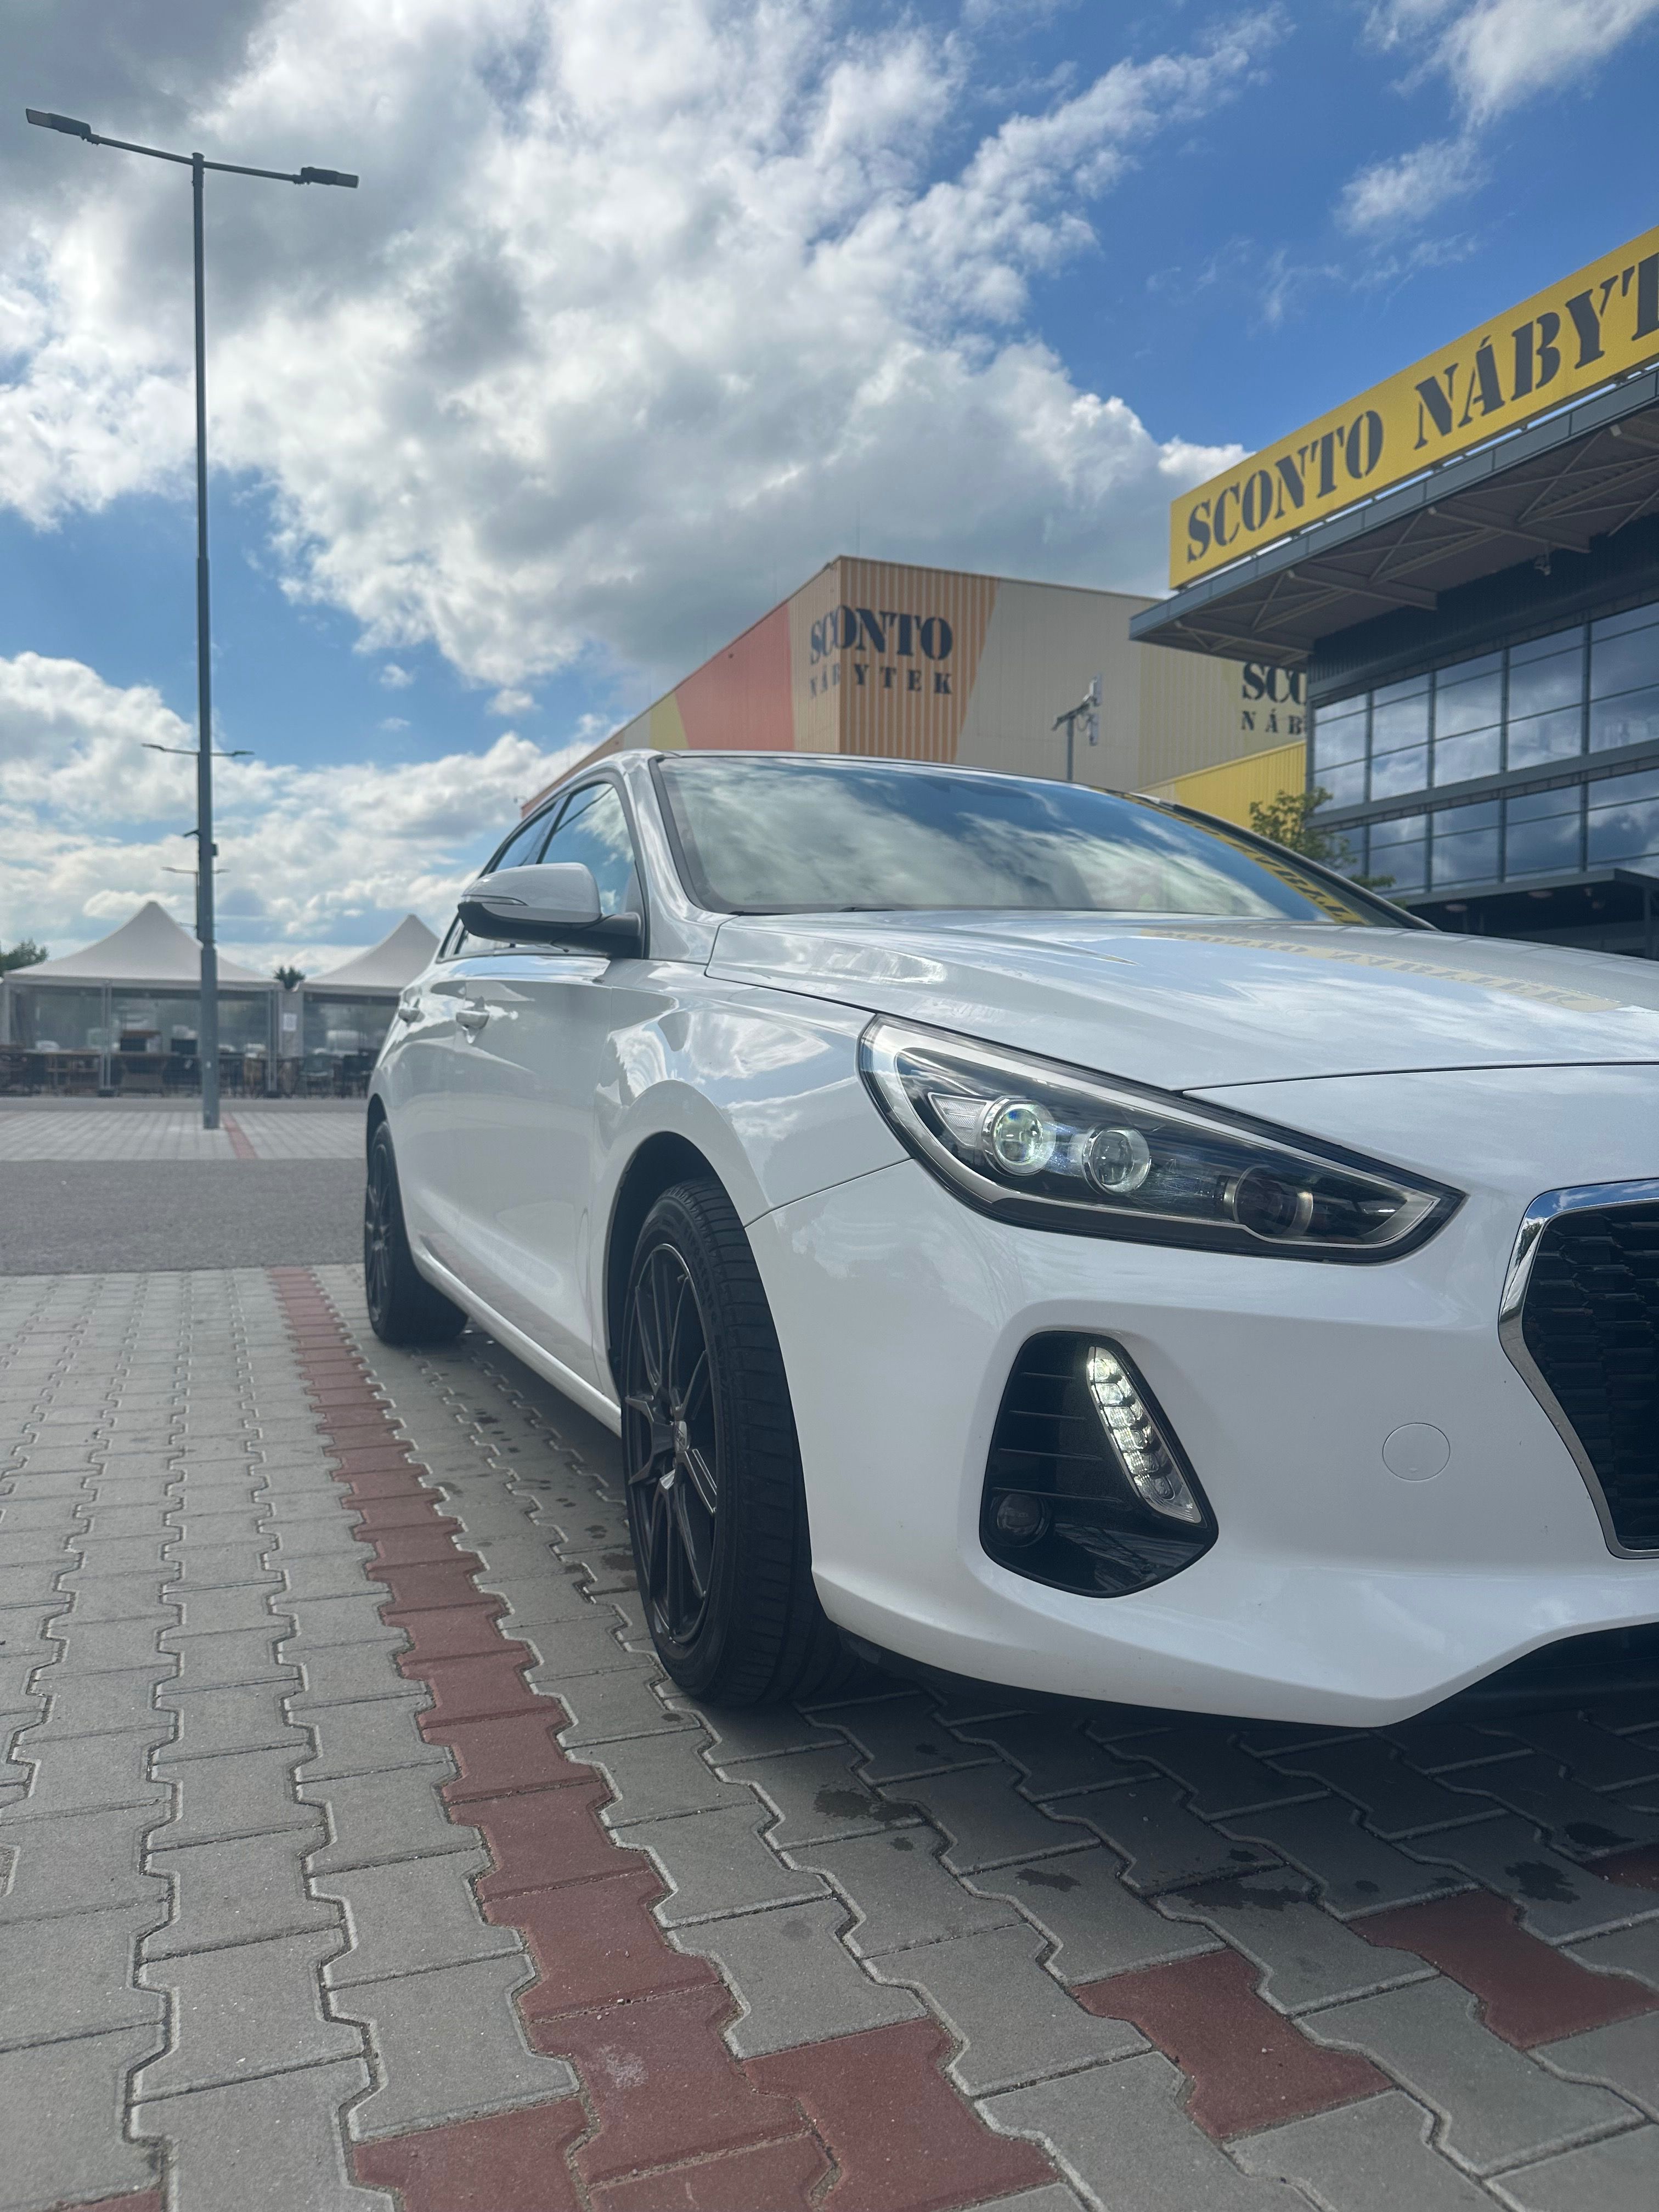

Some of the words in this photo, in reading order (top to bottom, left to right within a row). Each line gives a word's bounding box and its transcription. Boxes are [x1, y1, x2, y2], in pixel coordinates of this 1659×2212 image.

[1187, 410, 1383, 562] SCONTO
[1414, 251, 1659, 450] NÁBYT
[810, 605, 953, 665] SCONTO
